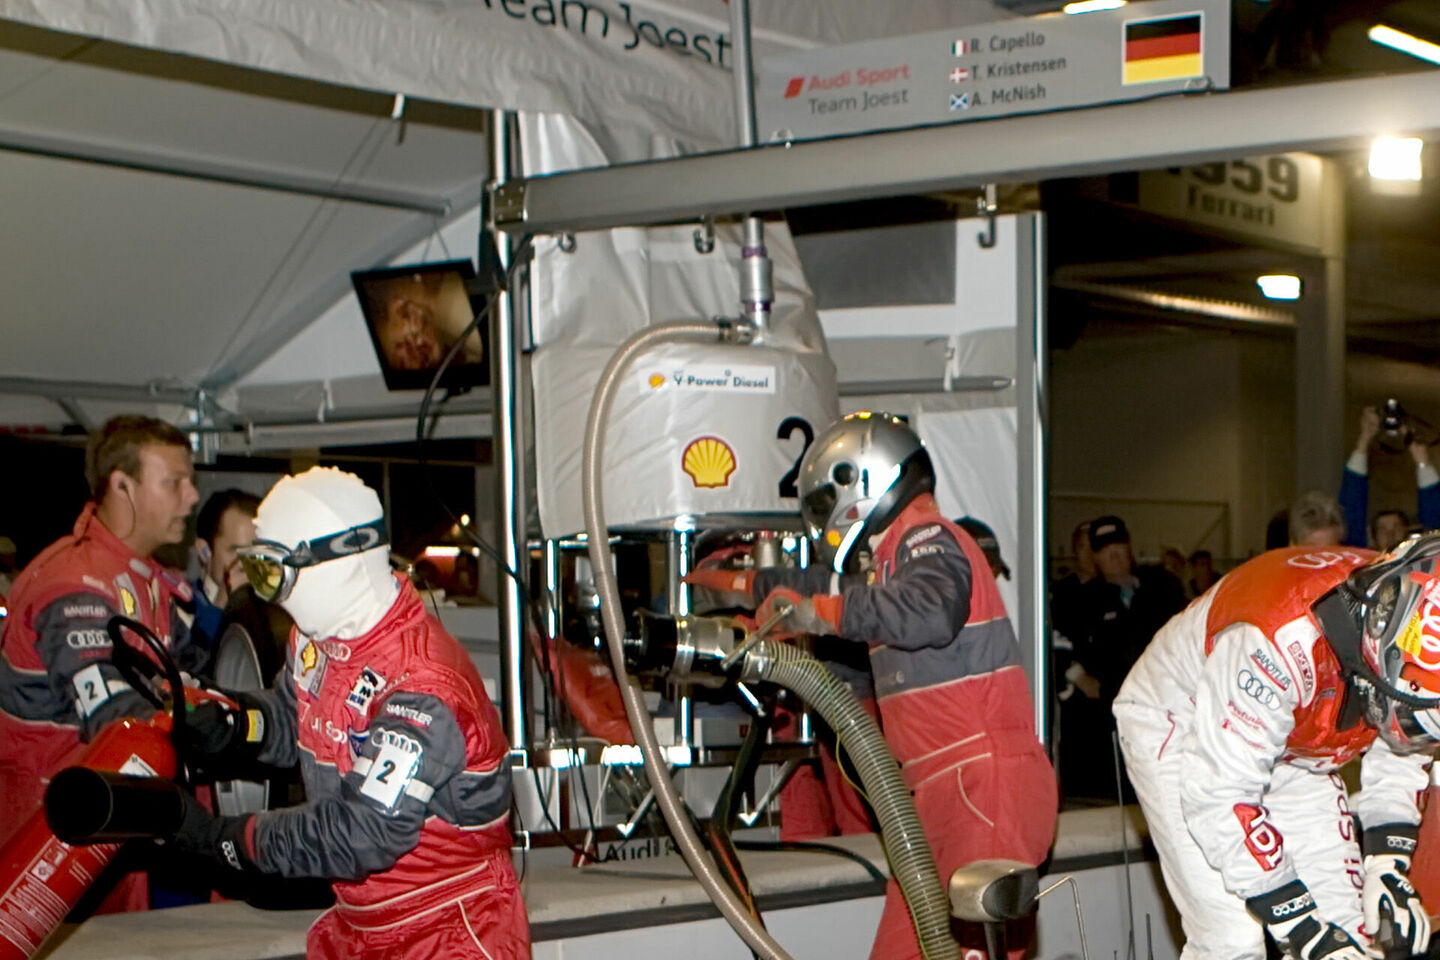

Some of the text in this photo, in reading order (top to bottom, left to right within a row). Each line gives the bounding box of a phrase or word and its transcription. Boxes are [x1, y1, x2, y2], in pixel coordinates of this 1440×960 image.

[484, 0, 732, 64] eam Joest
[989, 32, 1045, 52] Capello
[808, 64, 910, 92] Audi Sport
[986, 57, 1067, 78] Kristensen
[810, 89, 909, 115] Team Joest
[991, 83, 1047, 104] McNish
[733, 376, 769, 388] Diesel
[777, 416, 815, 498] 2
[84, 681, 99, 701] 2
[376, 759, 397, 784] 2
